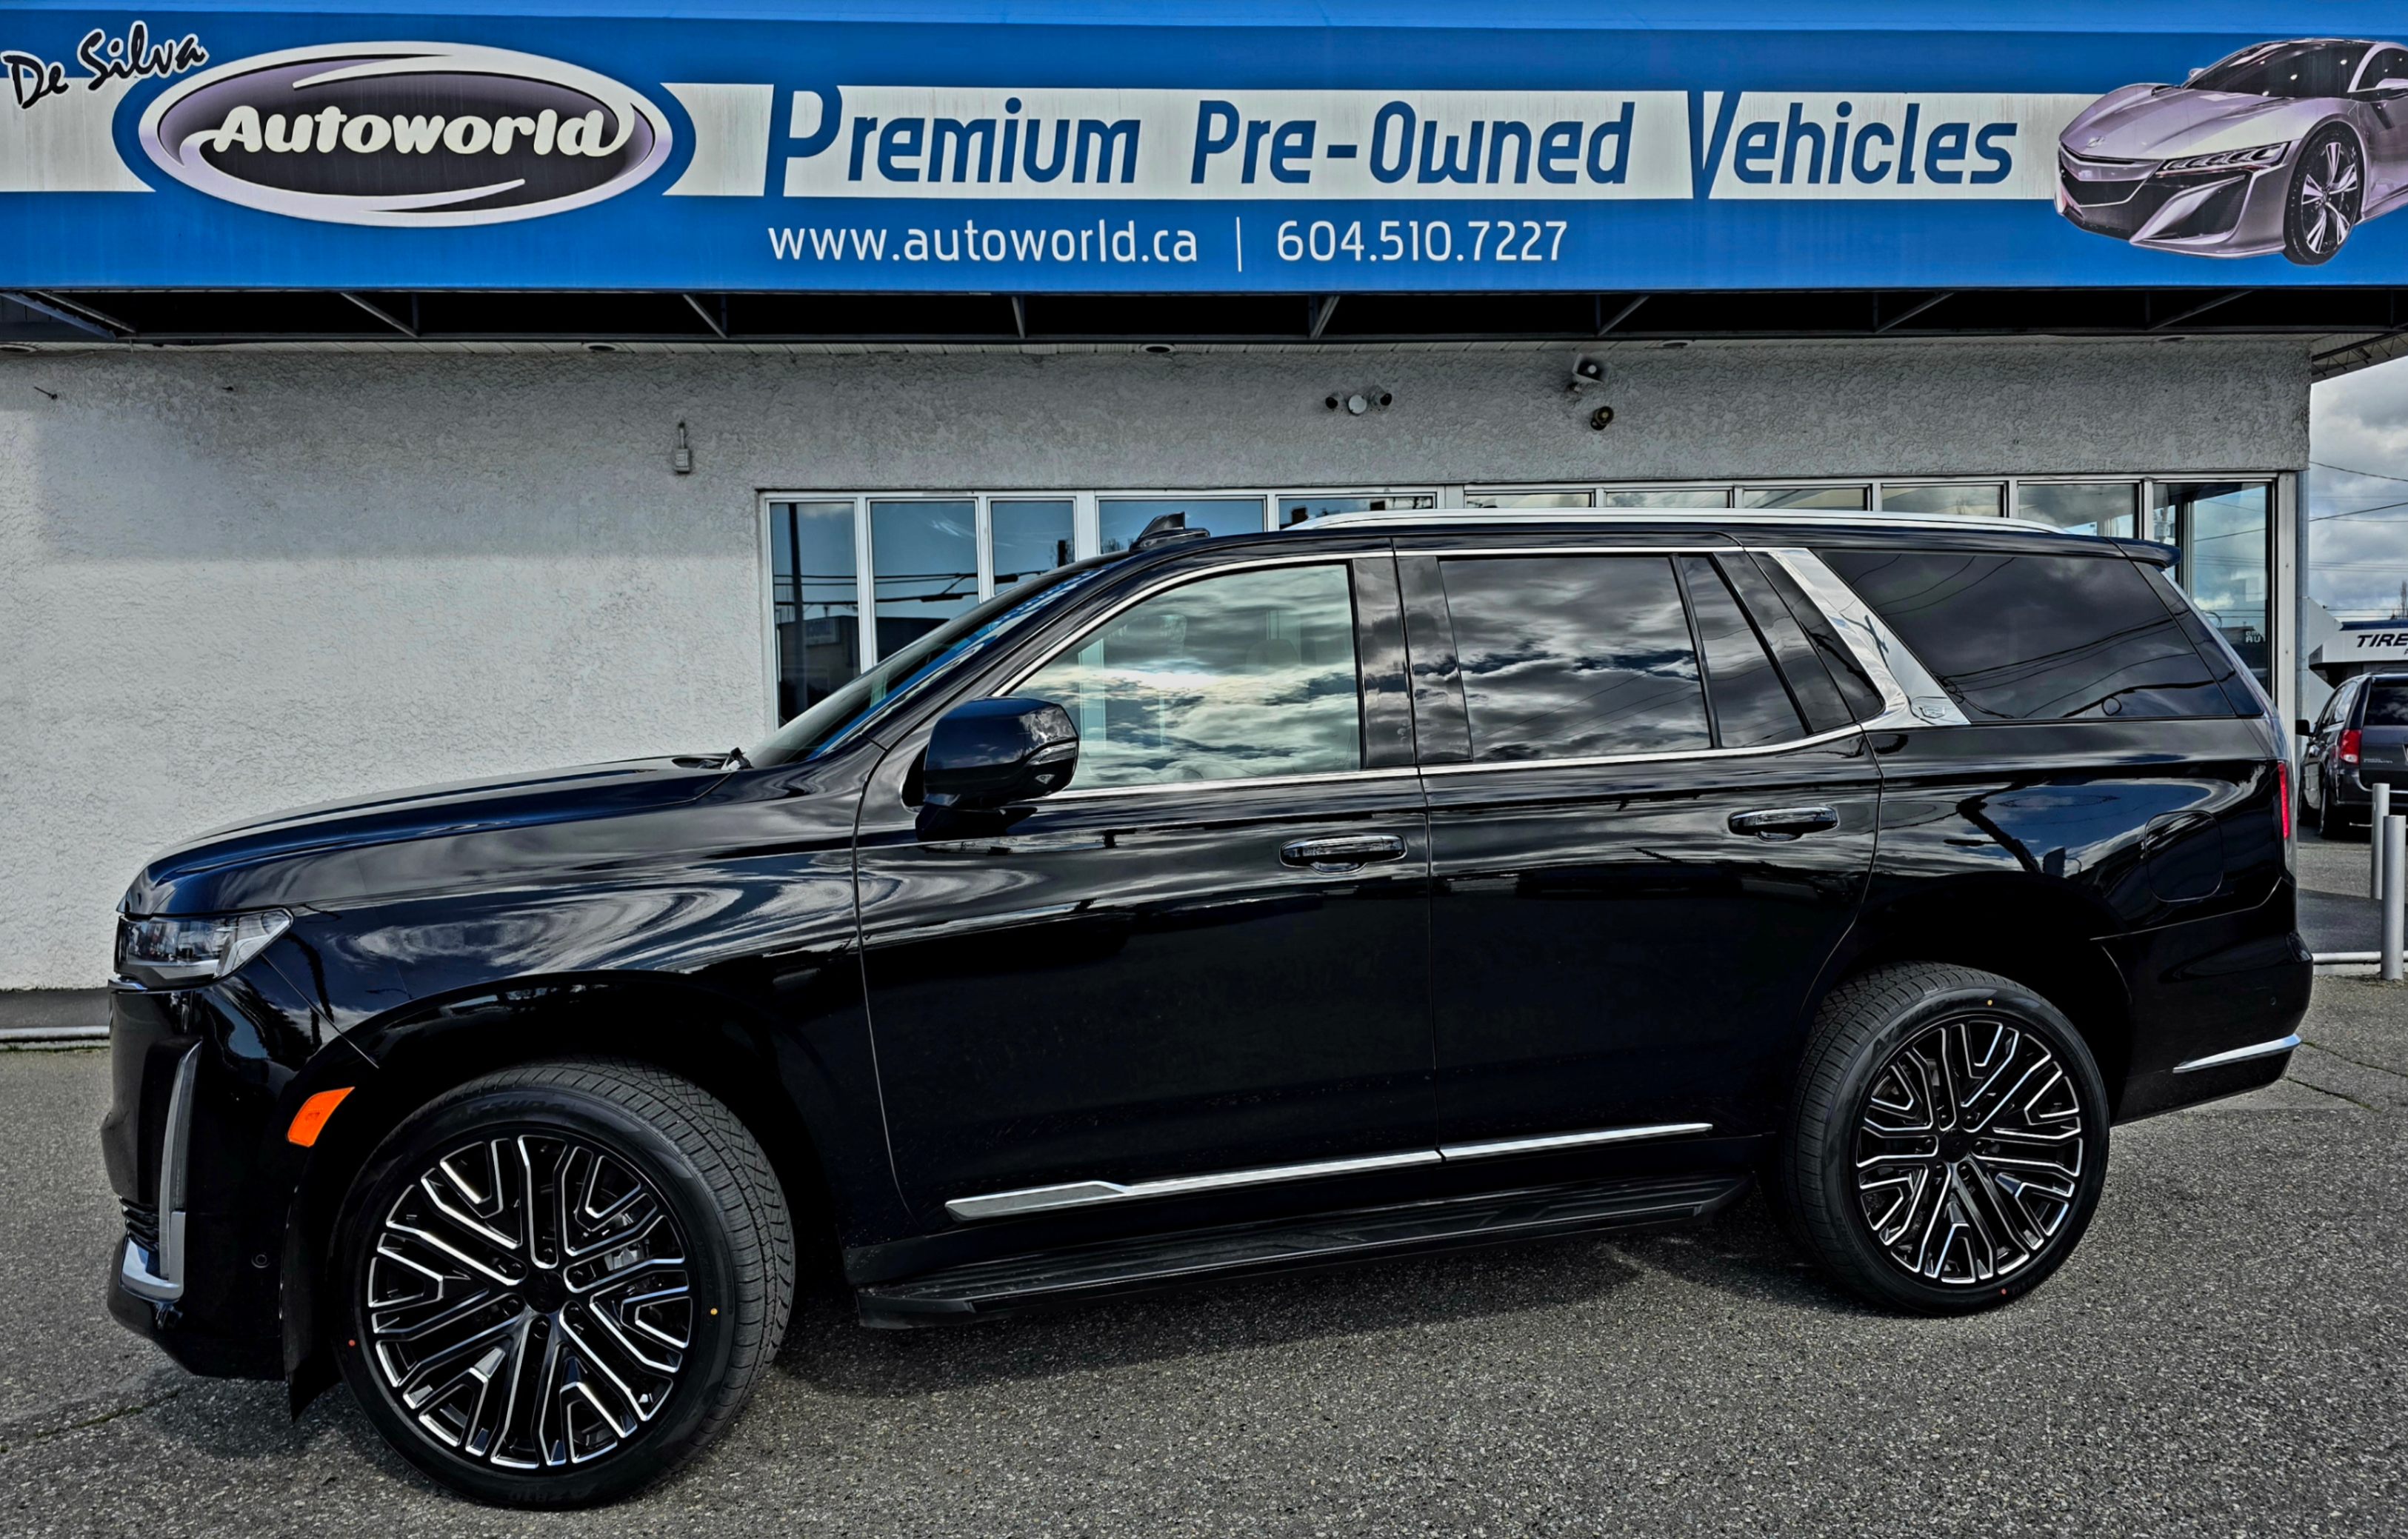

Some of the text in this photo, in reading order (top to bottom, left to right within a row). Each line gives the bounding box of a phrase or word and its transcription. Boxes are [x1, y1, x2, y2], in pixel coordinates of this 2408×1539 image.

[2, 23, 207, 109] De Silva
[212, 105, 611, 157] Autoworld
[764, 84, 2018, 198] Premium Pre-Owned Vehicles
[768, 219, 1568, 262] www.autoworld.ca 604.510.7227
